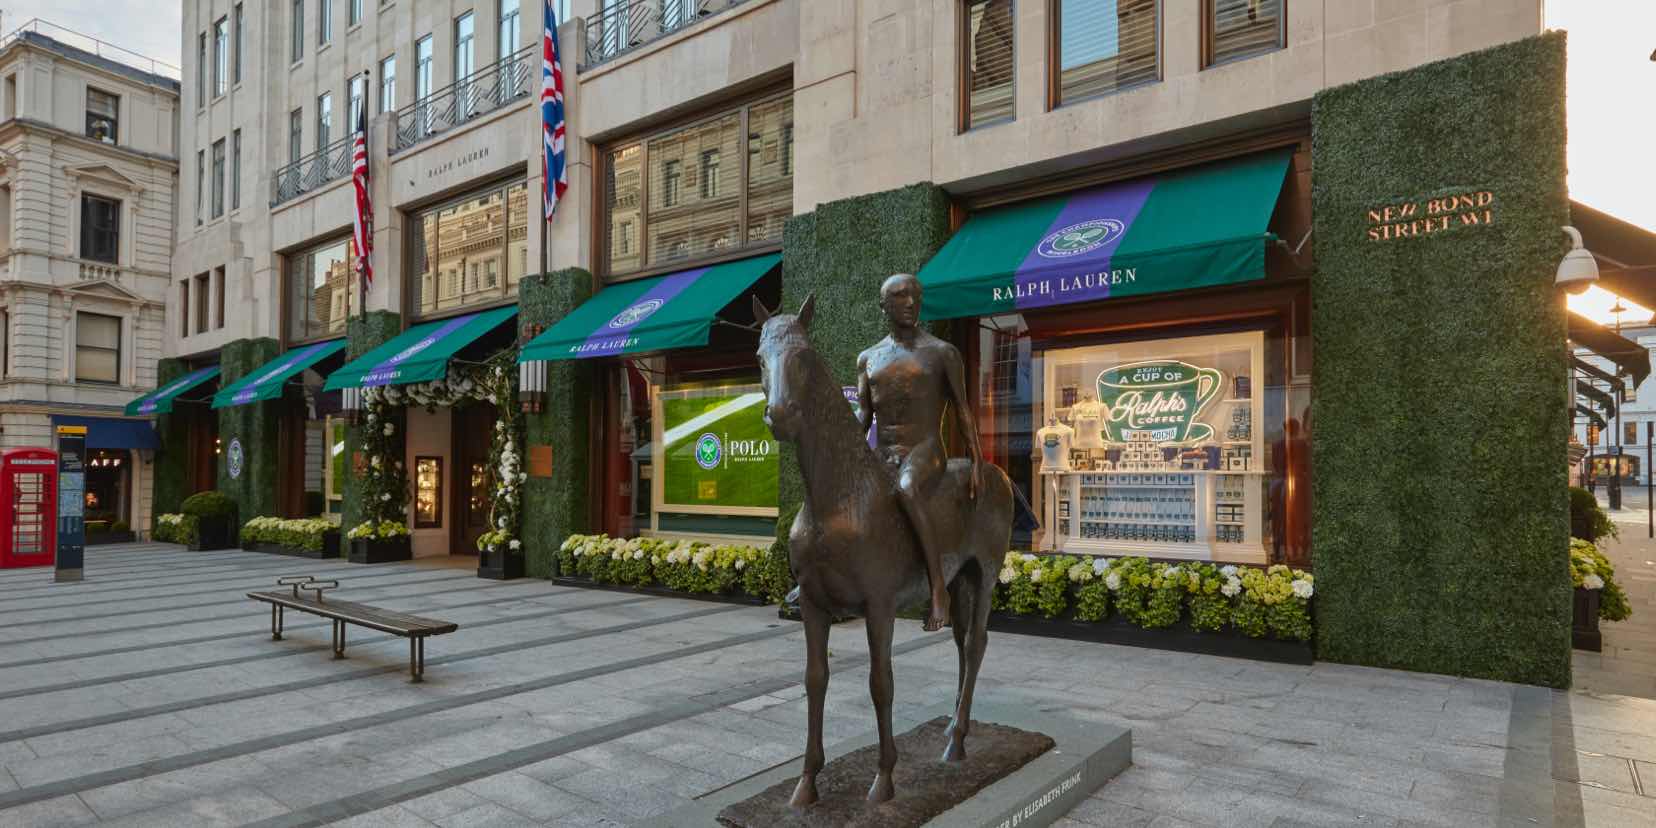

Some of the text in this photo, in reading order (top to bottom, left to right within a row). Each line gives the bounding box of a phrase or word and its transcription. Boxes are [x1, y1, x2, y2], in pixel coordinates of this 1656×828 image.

[1368, 191, 1493, 224] NEW BOND
[1368, 215, 1452, 241] STREET
[992, 267, 1137, 301] RALPH LAUREN
[569, 337, 640, 353] RALPH LAUREN
[1118, 372, 1183, 385] A CUP OF
[1109, 391, 1187, 429] Ralph's
[1137, 415, 1185, 425] COFFEE
[730, 440, 769, 456] POLO
[1012, 808, 1024, 828] BY
[1024, 785, 1061, 818] ELISABETH
[1061, 769, 1081, 794] FRINK
